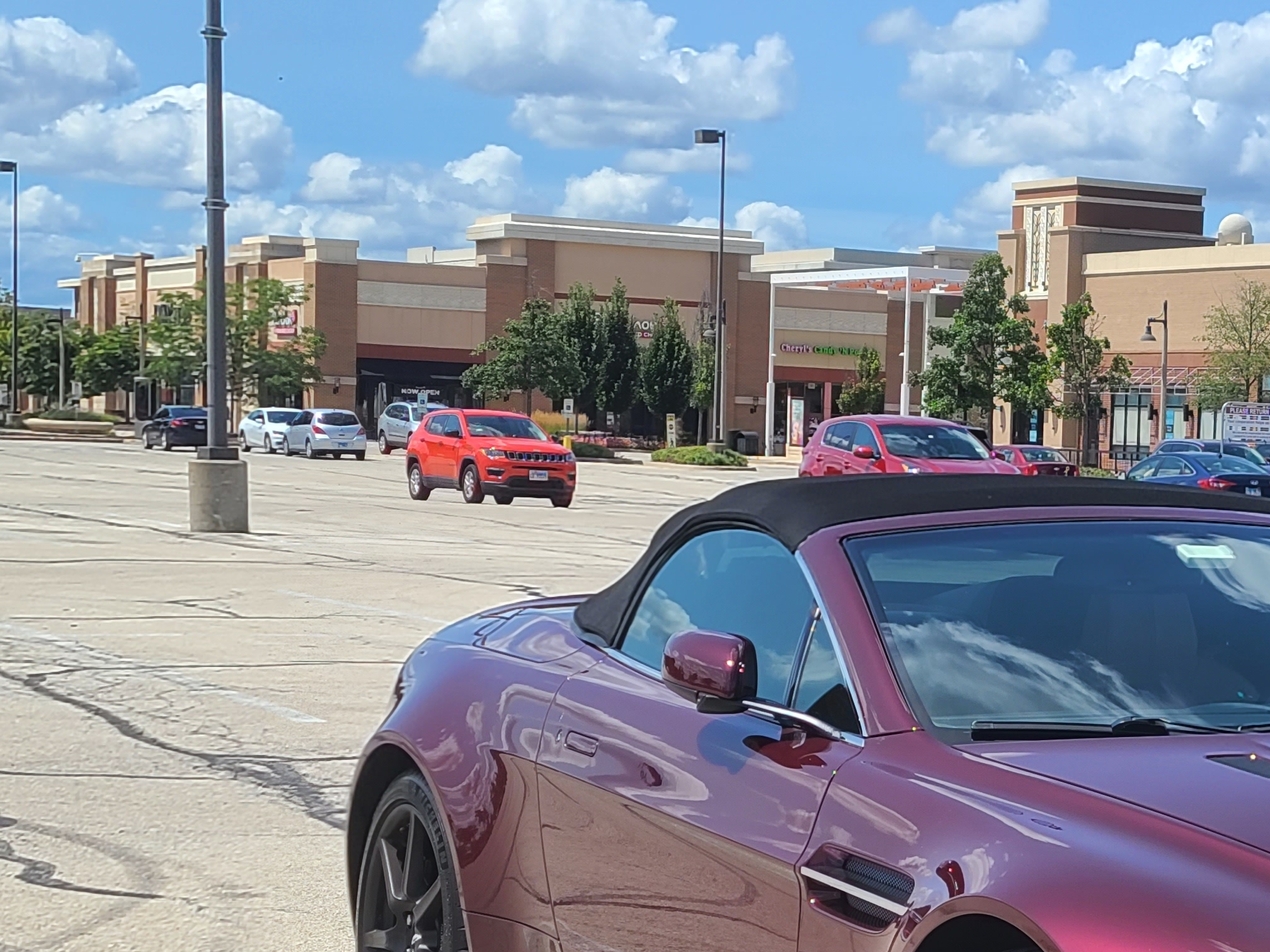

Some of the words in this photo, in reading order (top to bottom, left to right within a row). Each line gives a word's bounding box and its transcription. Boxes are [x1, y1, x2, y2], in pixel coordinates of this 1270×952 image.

[781, 343, 812, 353] Cheryl's
[814, 346, 836, 356] Candy
[1250, 408, 1269, 416] RETURN
[411, 784, 449, 870] MICHELIN
